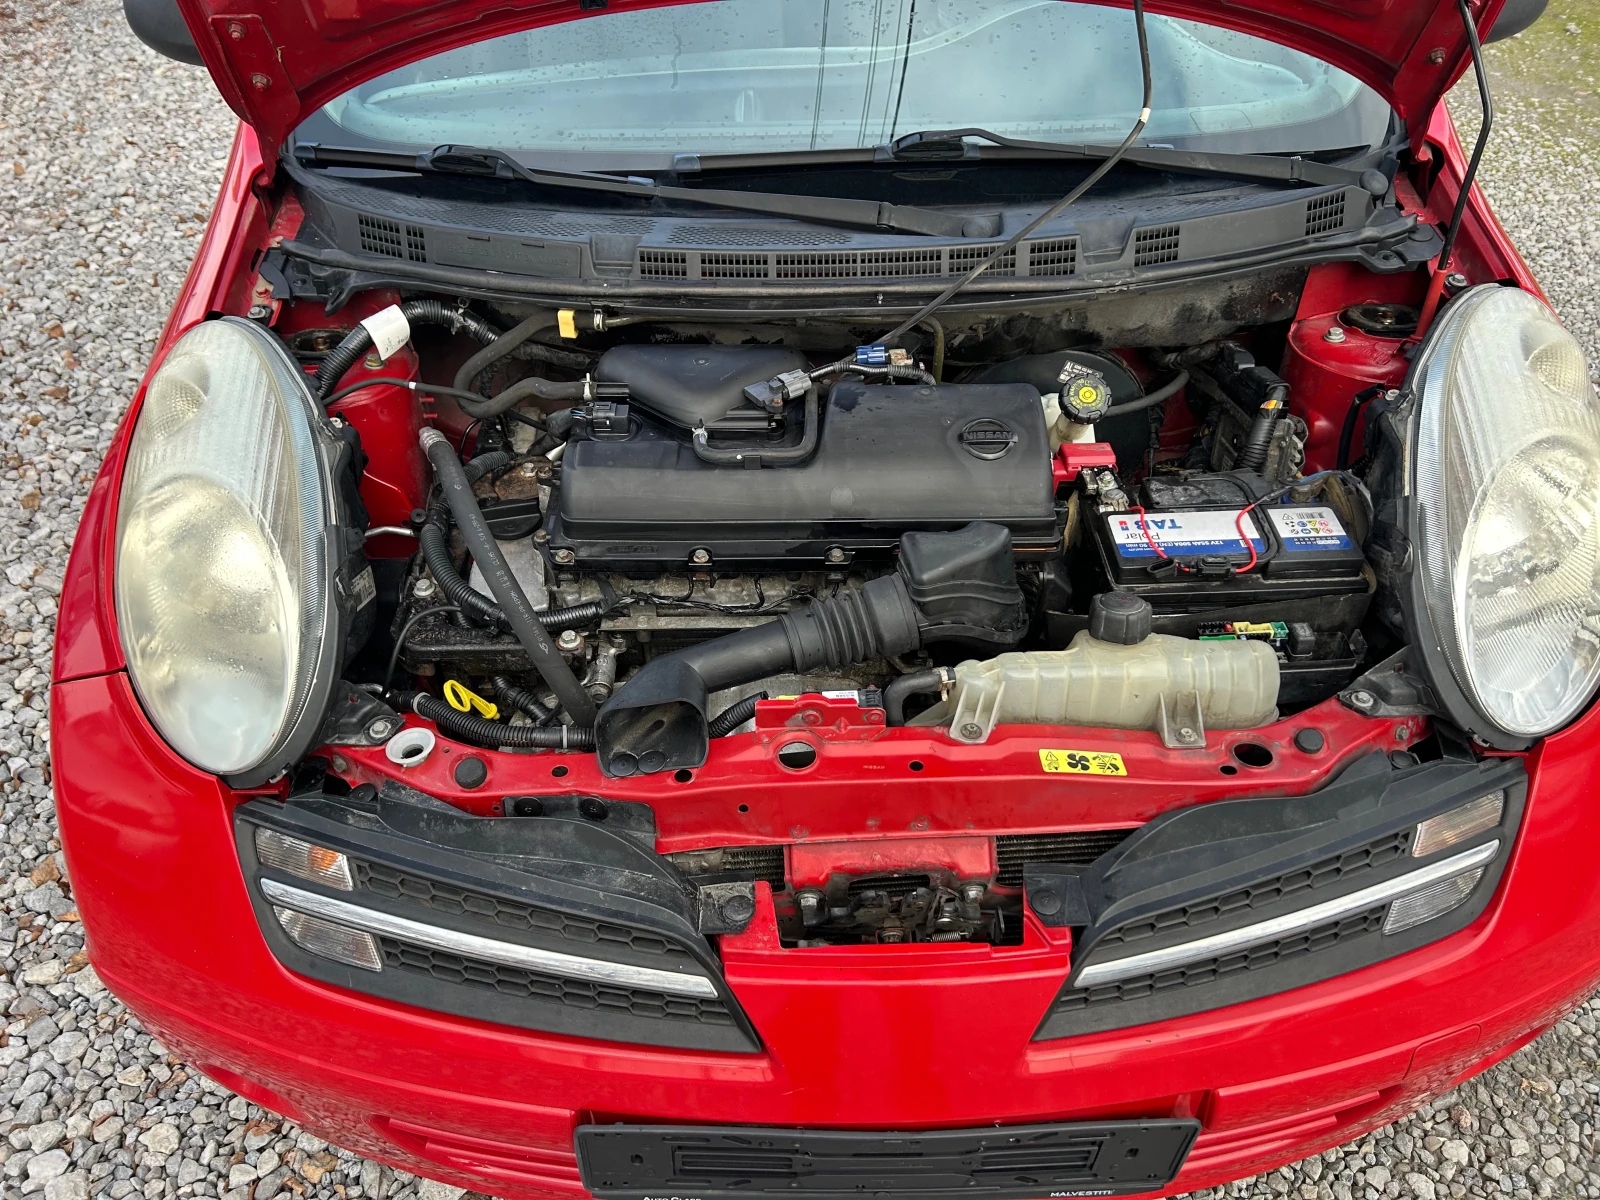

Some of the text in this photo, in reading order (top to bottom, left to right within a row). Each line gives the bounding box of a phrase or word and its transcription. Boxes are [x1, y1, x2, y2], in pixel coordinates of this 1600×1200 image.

[963, 431, 1014, 440] NISSAN
[1134, 519, 1182, 530] TAB
[1125, 532, 1160, 540] Polar
